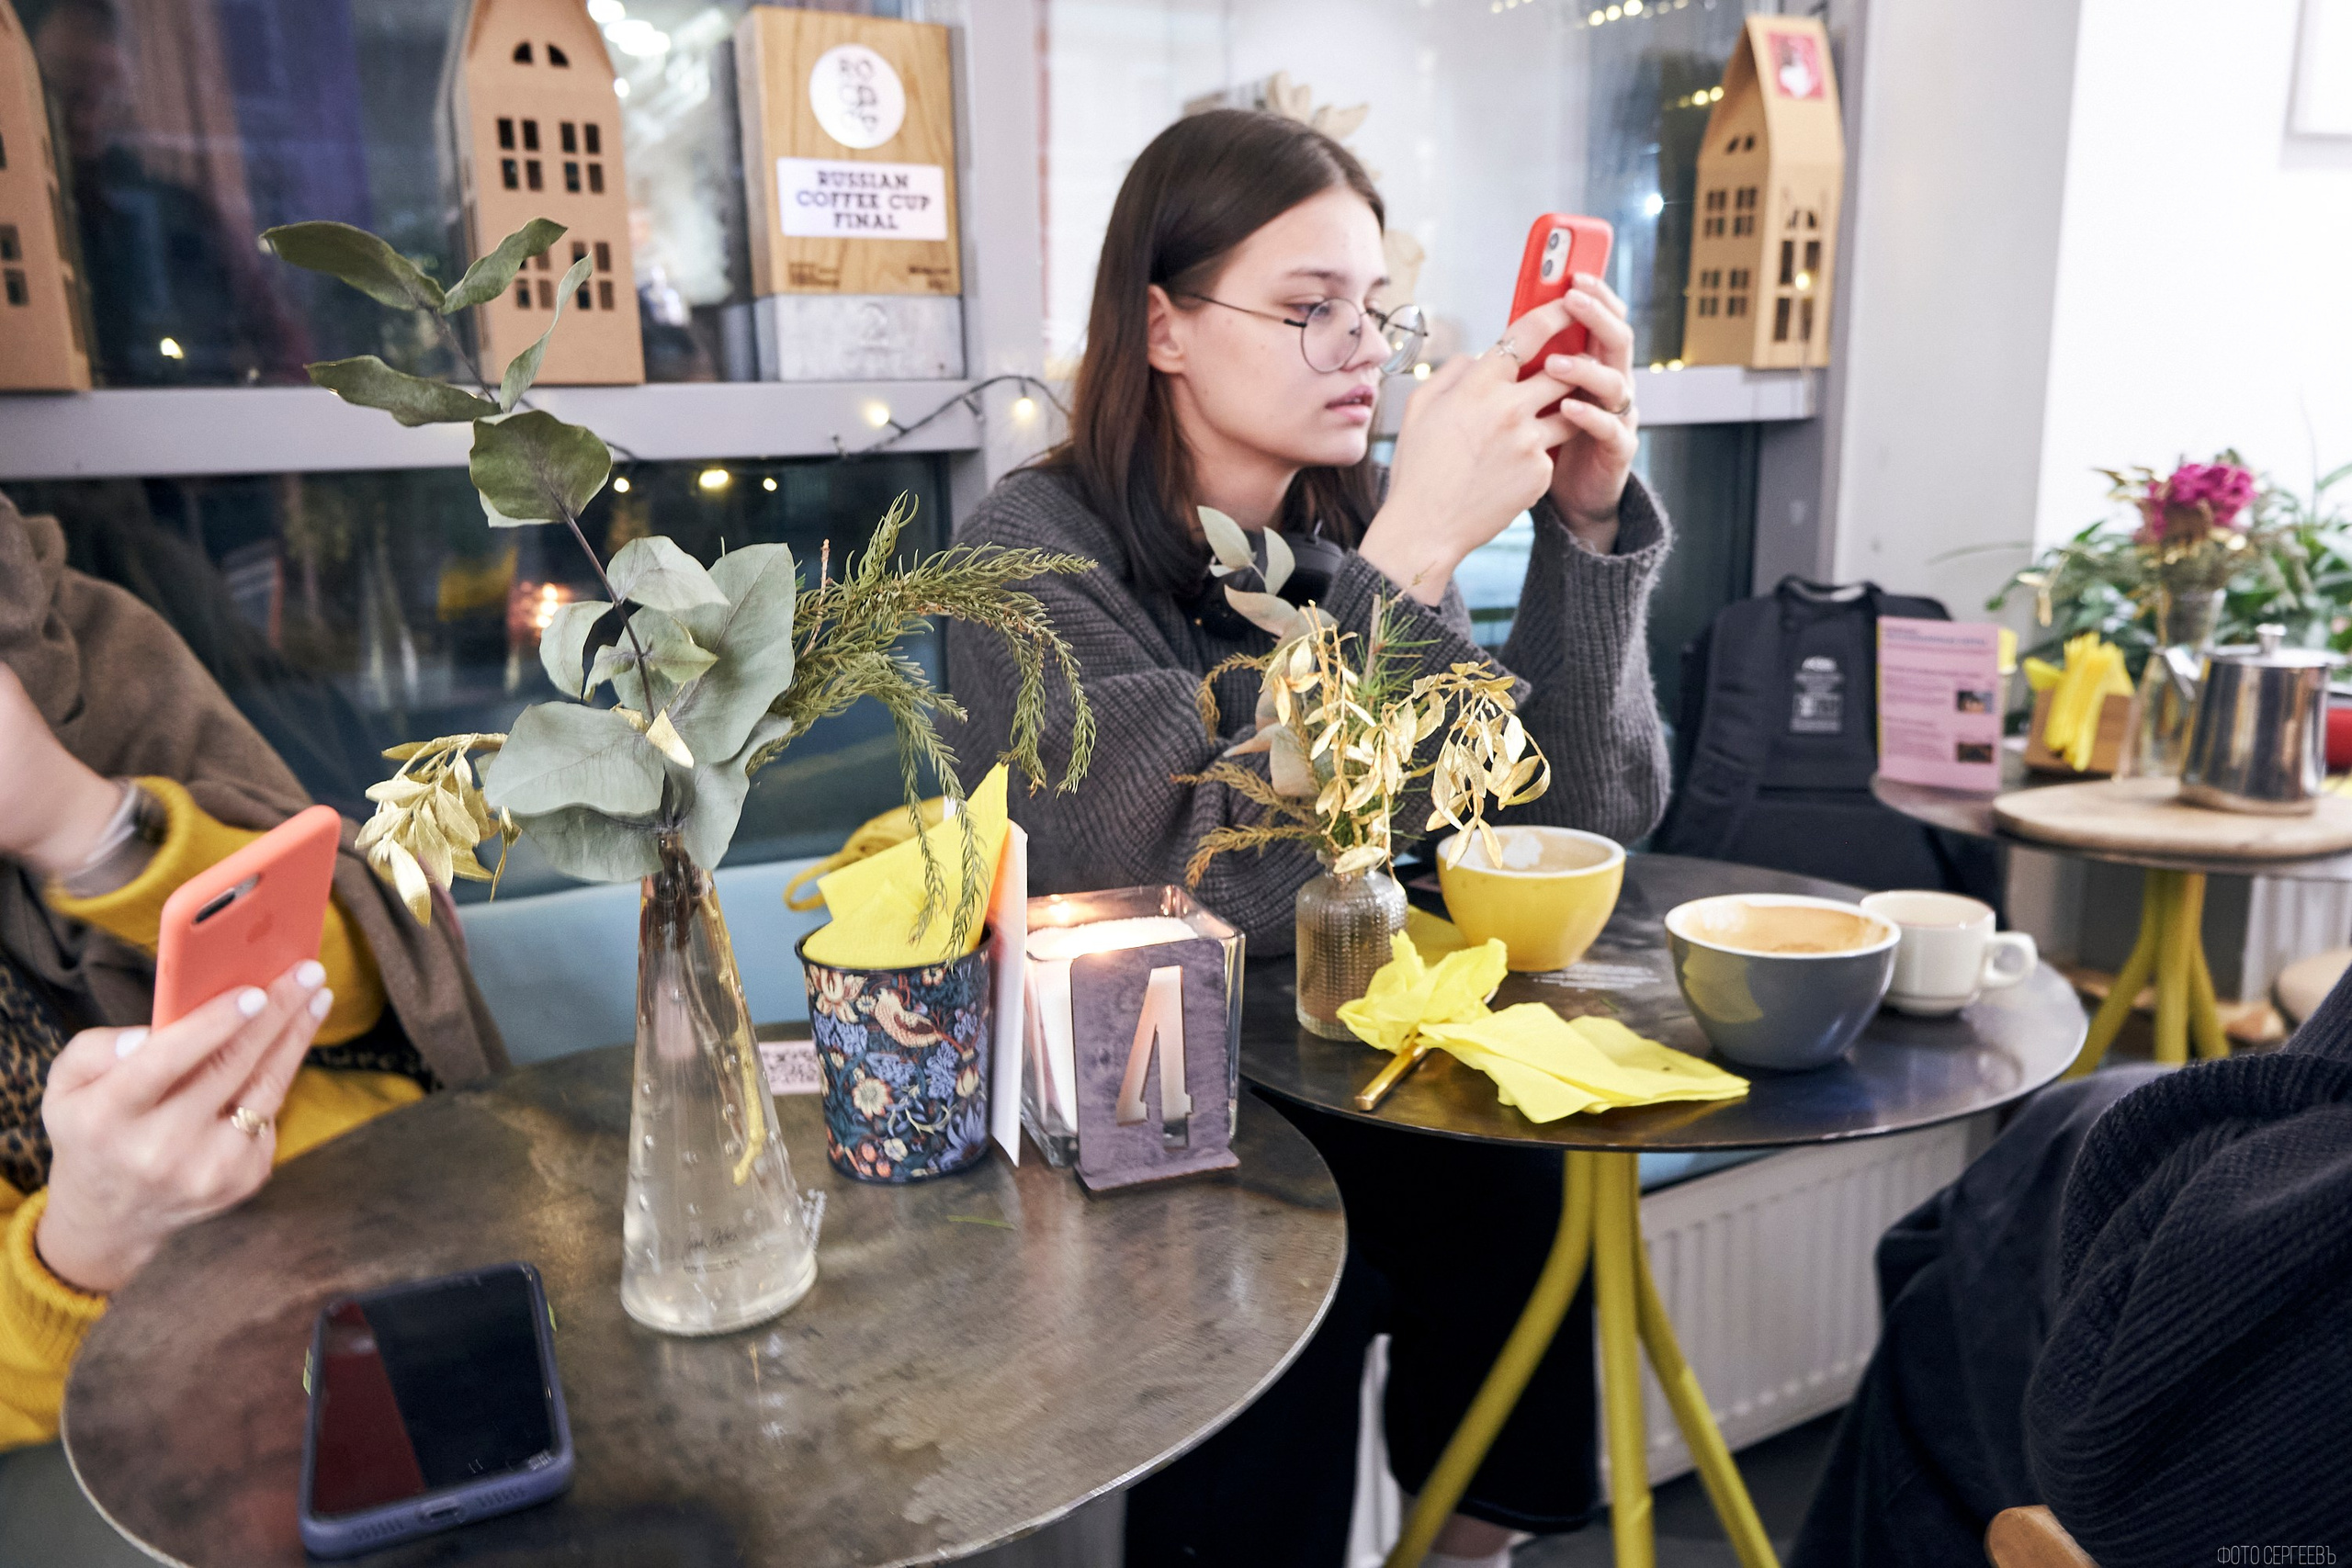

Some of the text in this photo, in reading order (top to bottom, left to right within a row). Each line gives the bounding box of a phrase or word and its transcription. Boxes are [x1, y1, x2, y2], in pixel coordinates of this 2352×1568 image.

[817, 170, 909, 188] RUSSIAN
[797, 190, 931, 210] COFFEE CUP
[834, 212, 899, 230] FINAL
[1114, 964, 1193, 1148] 4
